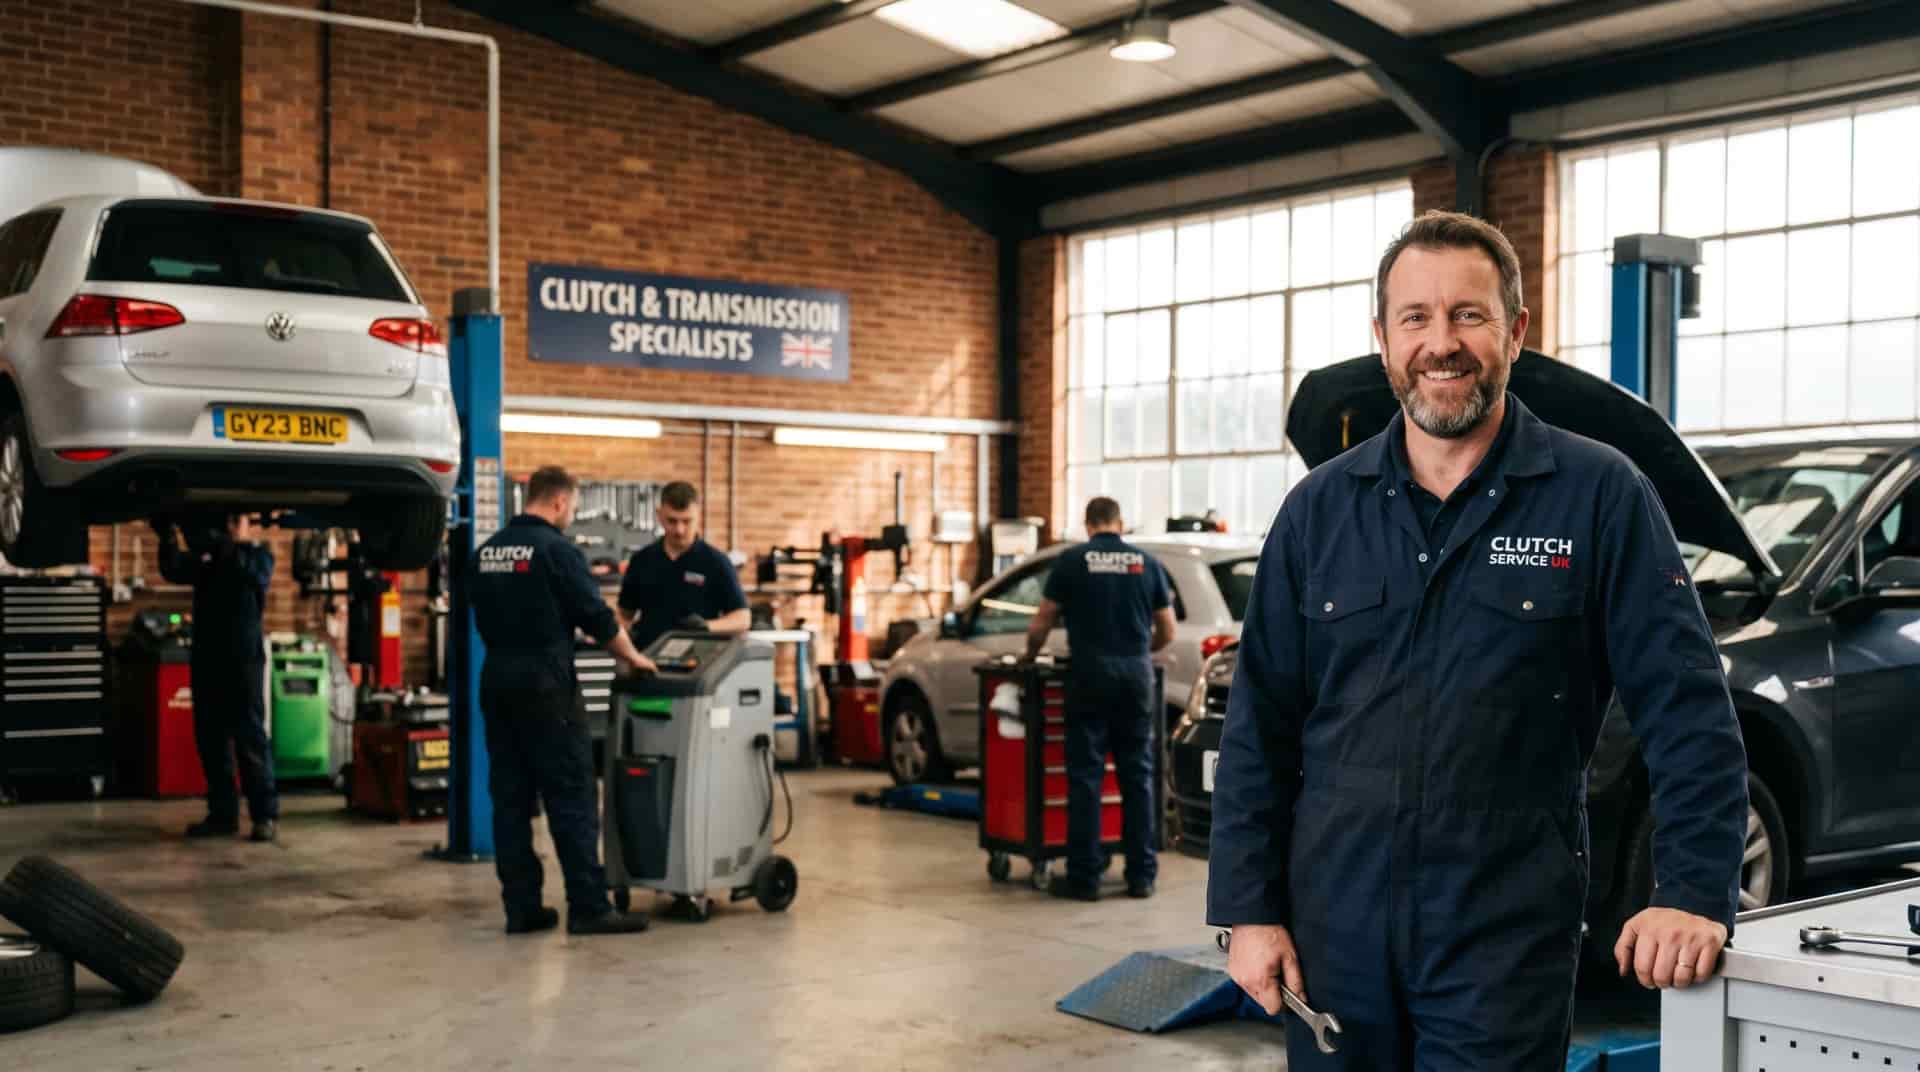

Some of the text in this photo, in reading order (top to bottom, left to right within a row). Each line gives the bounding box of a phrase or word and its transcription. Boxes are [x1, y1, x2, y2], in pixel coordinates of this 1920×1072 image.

[540, 277, 840, 332] CLUTCH & TRANSMISSION
[609, 321, 753, 361] SPECIALISTS
[230, 413, 343, 437] GY23 BNC
[480, 545, 535, 560] CLUTCH
[1490, 536, 1573, 555] CLUTCH
[1488, 553, 1570, 568] SERVICE UK
